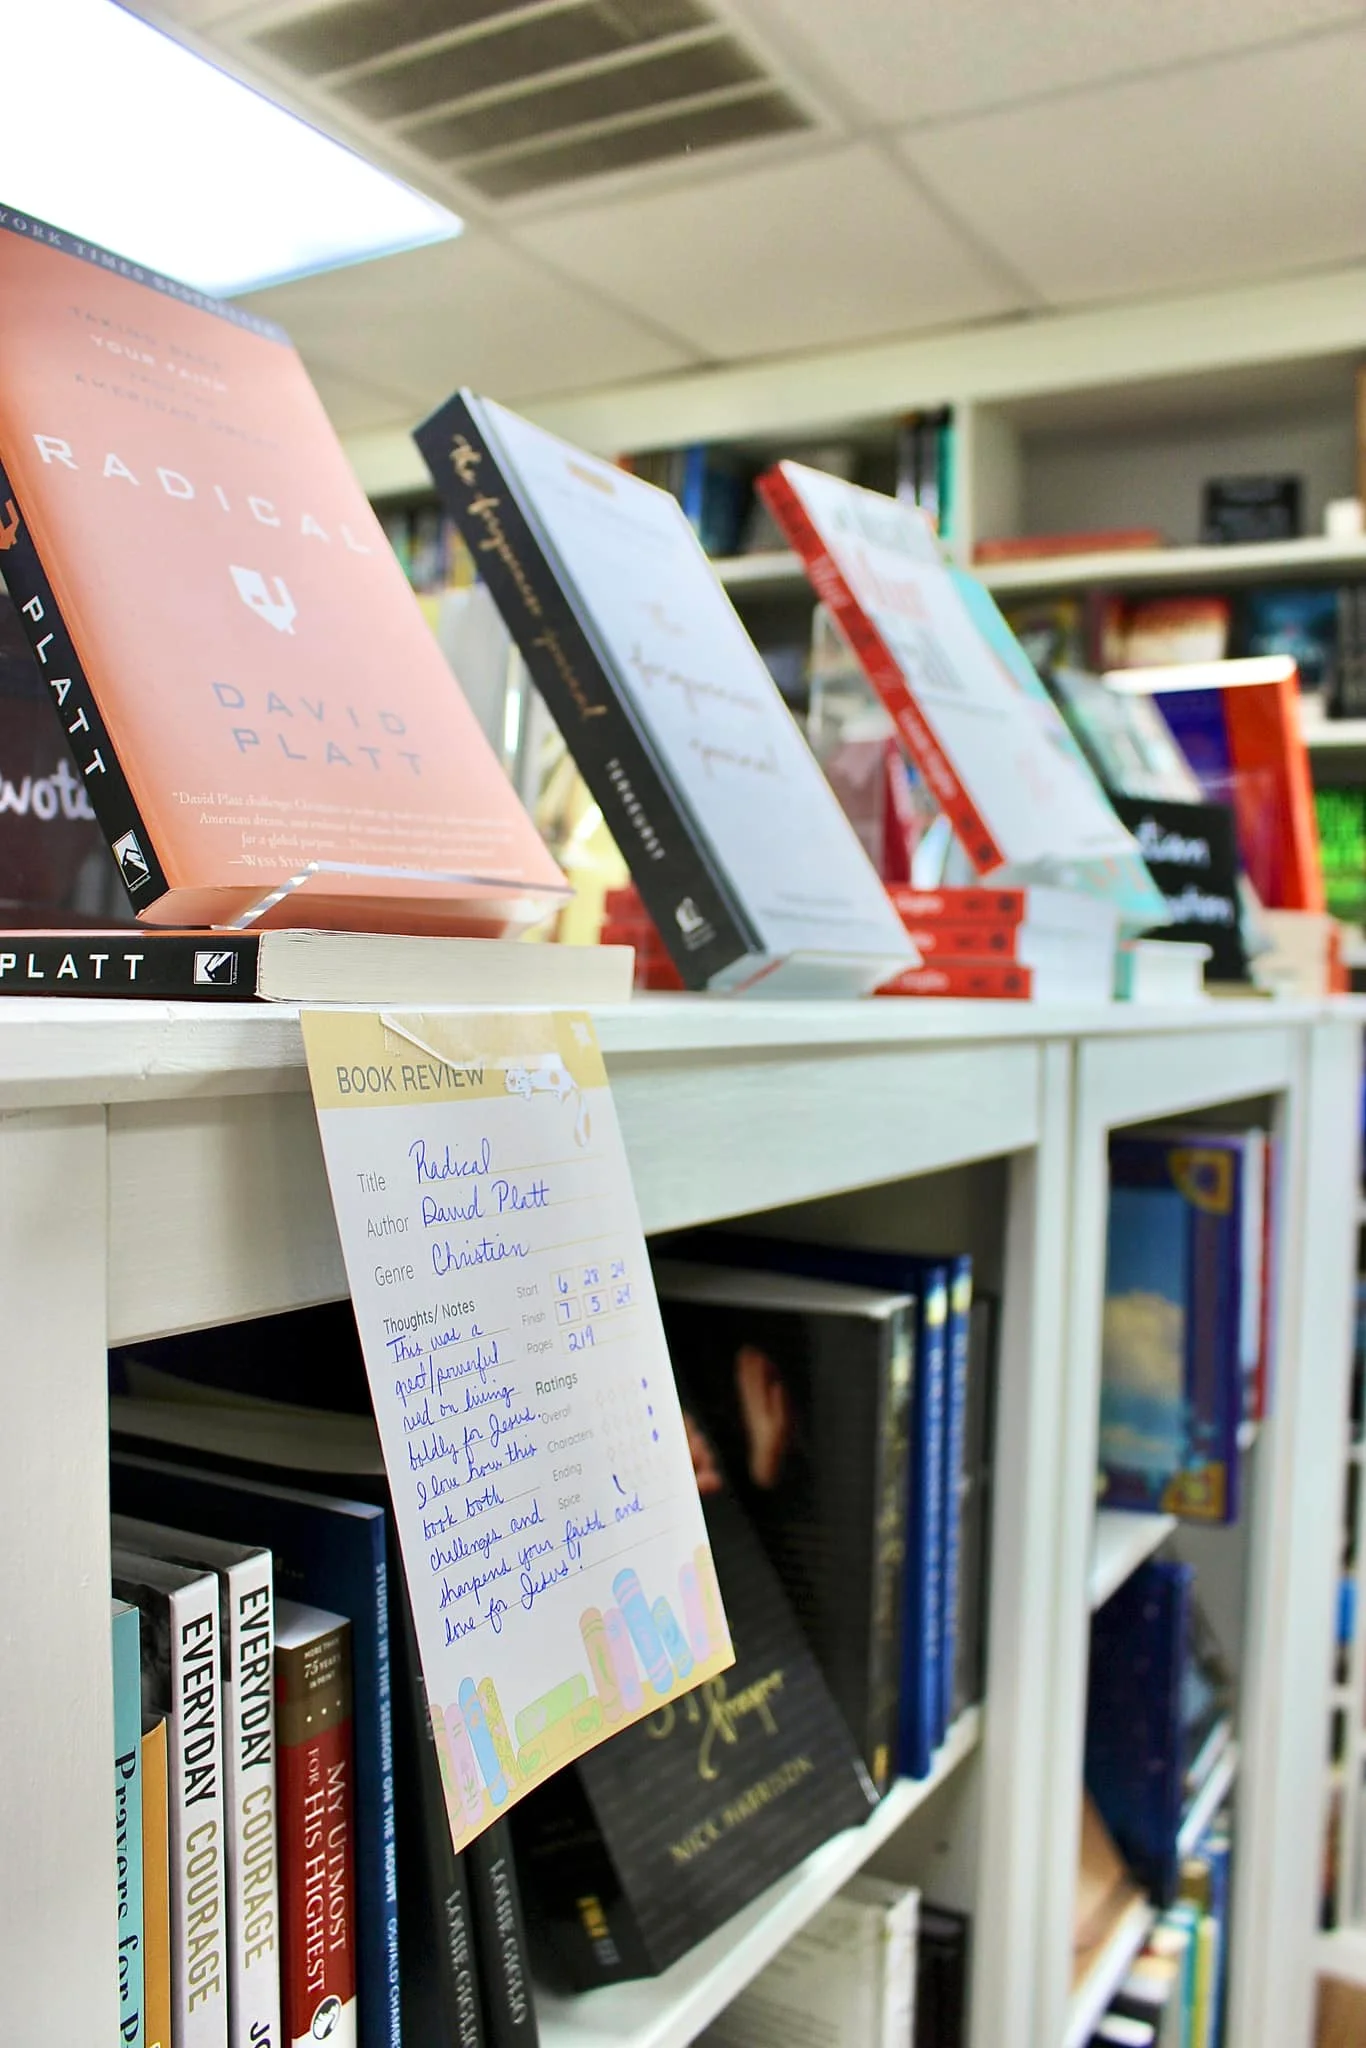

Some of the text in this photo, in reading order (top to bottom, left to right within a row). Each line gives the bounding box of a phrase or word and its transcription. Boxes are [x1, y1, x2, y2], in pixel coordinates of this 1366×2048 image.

[0, 209, 62, 246] YORK
[73, 241, 145, 282] TIMES
[33, 433, 374, 556] RADICAL
[22, 595, 107, 776] PLATT
[211, 681, 407, 736] DAVID
[231, 726, 422, 776] PLATT
[0, 953, 145, 980] PLATT
[336, 1063, 484, 1094] BOOK REVIEW
[357, 1171, 387, 1193] Title
[408, 1137, 491, 1184] Radical
[421, 1178, 550, 1228] David Platt
[367, 1216, 410, 1238] Author
[374, 1263, 415, 1287] Genre
[431, 1232, 531, 1276] Christian
[516, 1283, 539, 1299] Start
[558, 1274, 569, 1294] 6
[383, 1299, 476, 1335] Thoughts/ Notes
[521, 1311, 546, 1327] Finish
[559, 1302, 571, 1319] 7
[591, 1295, 601, 1313] 5
[386, 1323, 484, 1363] This was a
[526, 1339, 554, 1355] Pages
[568, 1324, 596, 1352] 219
[439, 1403, 459, 1417] on
[463, 1378, 516, 1409] living
[535, 1372, 579, 1396] Ratings
[541, 1403, 572, 1425] Overall
[408, 1407, 542, 1471] boldly for Jesus.
[547, 1428, 595, 1454] Characters
[416, 1433, 538, 1511] I love how this
[552, 1463, 583, 1482] Ending
[422, 1484, 505, 1541] book both
[558, 1493, 582, 1511] Spice
[430, 1498, 546, 1573] challenges and
[517, 1538, 554, 1571] your
[562, 1510, 606, 1560] faith
[615, 1491, 645, 1523] and
[444, 1616, 477, 1648] love
[484, 1596, 508, 1634] for
[304, 1658, 319, 1679] 75
[375, 1561, 397, 1903] STUDIES IN THE SERMON ON THE MOUNT
[240, 1584, 274, 1970] EVERYDAY COURAGE
[181, 1611, 220, 2014] EVERYDAY COURAGE
[327, 1760, 347, 1952] MY UTMOST
[669, 1817, 721, 1867] NICK
[304, 1747, 326, 1993] FOR HIS HIGHEST
[117, 1933, 139, 2003] for
[386, 1917, 399, 1983] OSWALD
